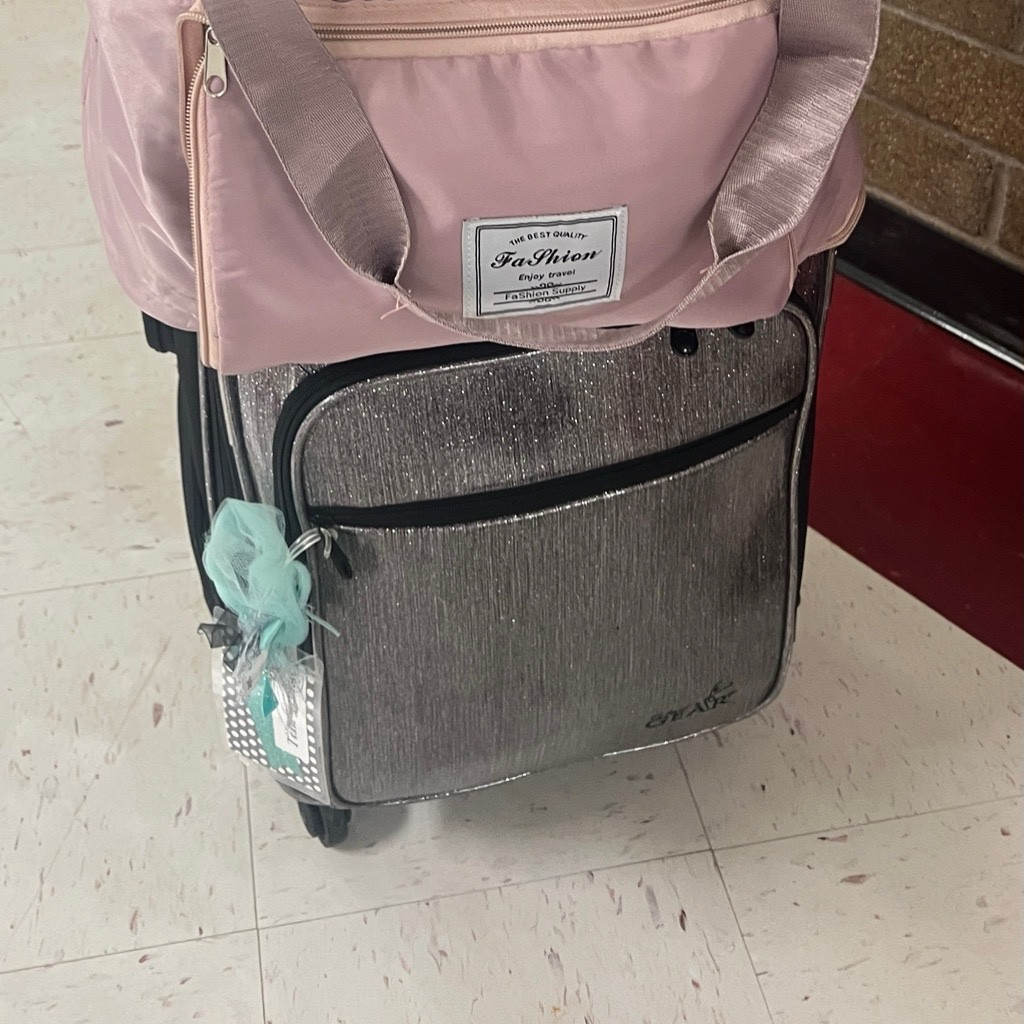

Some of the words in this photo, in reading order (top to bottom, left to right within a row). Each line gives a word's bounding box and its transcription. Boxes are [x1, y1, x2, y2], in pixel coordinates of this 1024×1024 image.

[509, 235, 526, 246] THE
[527, 231, 551, 241] BEST
[553, 230, 588, 241] QUALITY
[518, 273, 545, 282] Enjoy
[548, 269, 576, 279] travel
[504, 290, 549, 301] FaShion
[552, 284, 586, 296] Supply
